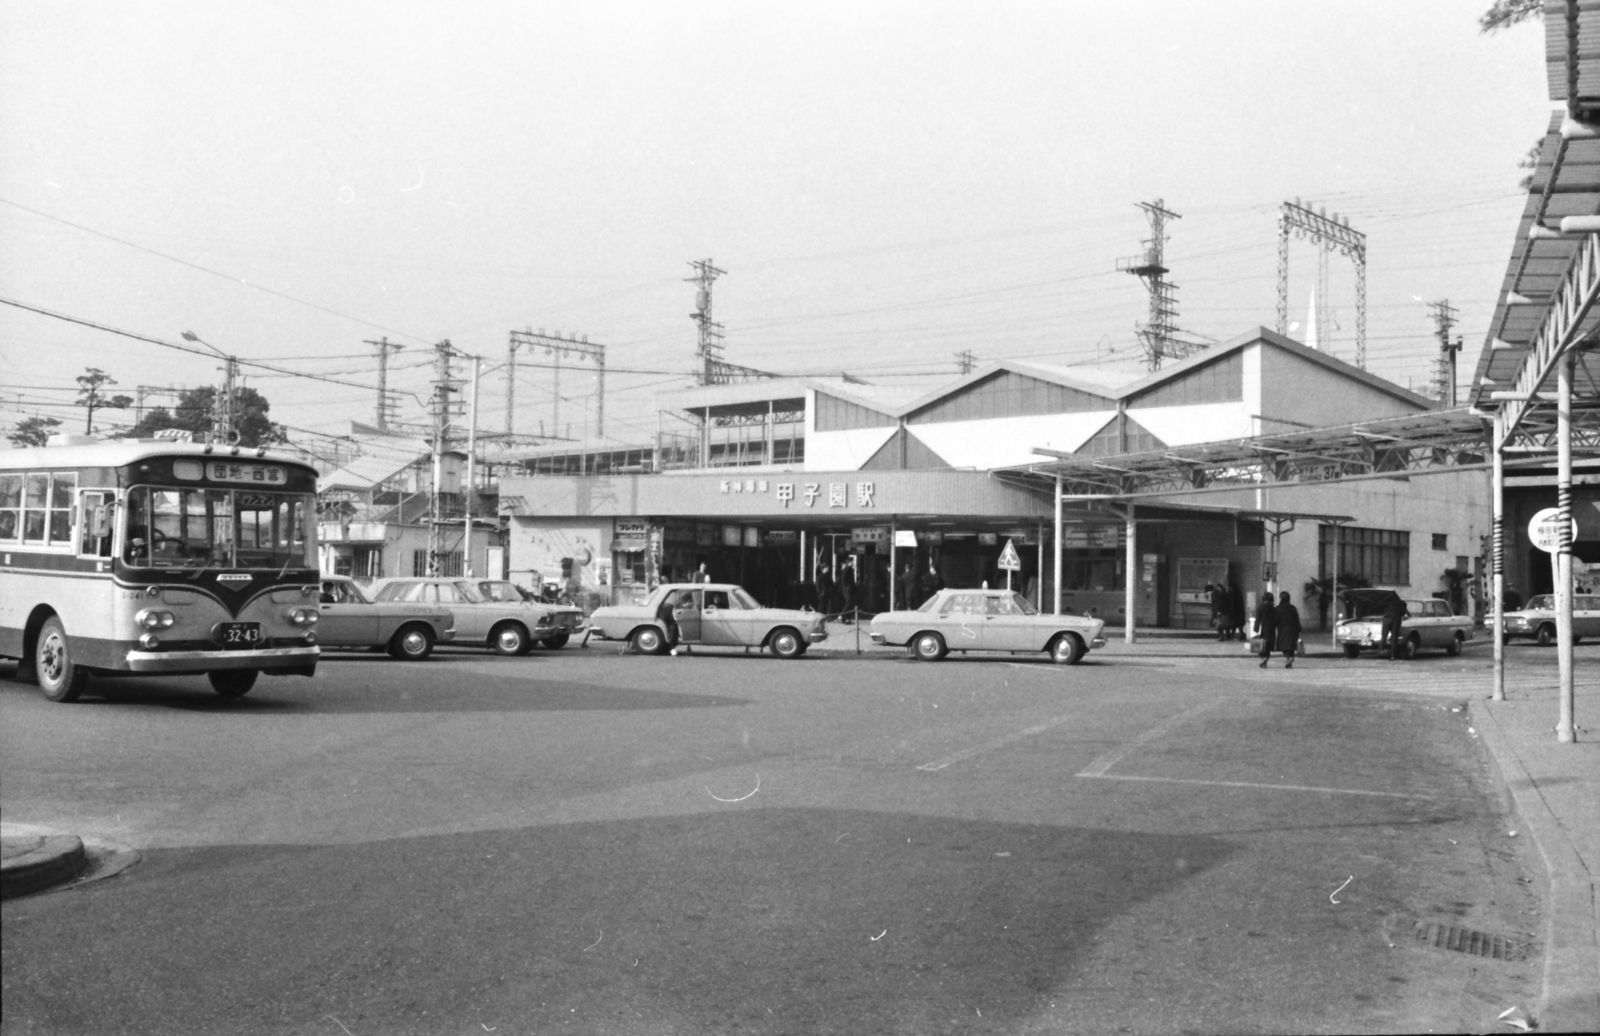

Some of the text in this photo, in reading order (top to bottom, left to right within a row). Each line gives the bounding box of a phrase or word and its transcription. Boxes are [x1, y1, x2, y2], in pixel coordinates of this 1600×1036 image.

[777, 482, 876, 509] 甲子園駅
[227, 629, 258, 642] 32-43
